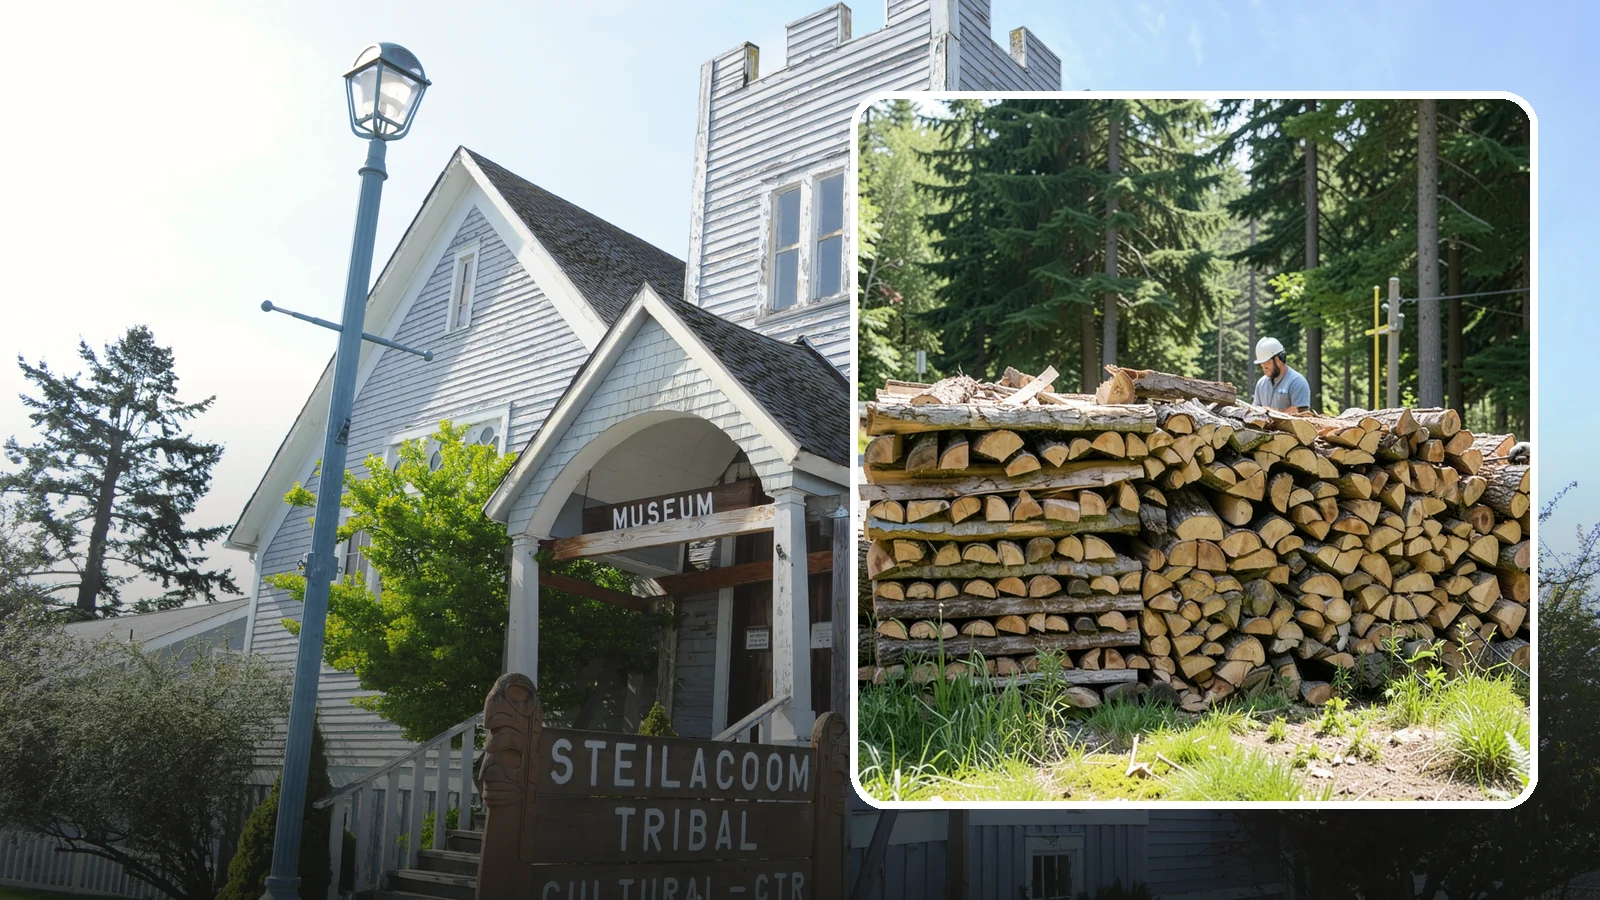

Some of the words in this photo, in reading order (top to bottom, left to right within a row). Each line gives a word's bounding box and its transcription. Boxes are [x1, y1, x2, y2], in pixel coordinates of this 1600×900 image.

[613, 491, 714, 531] MUSEUM
[551, 738, 809, 792] STEILACOOM
[615, 807, 757, 851] TRIBAL
